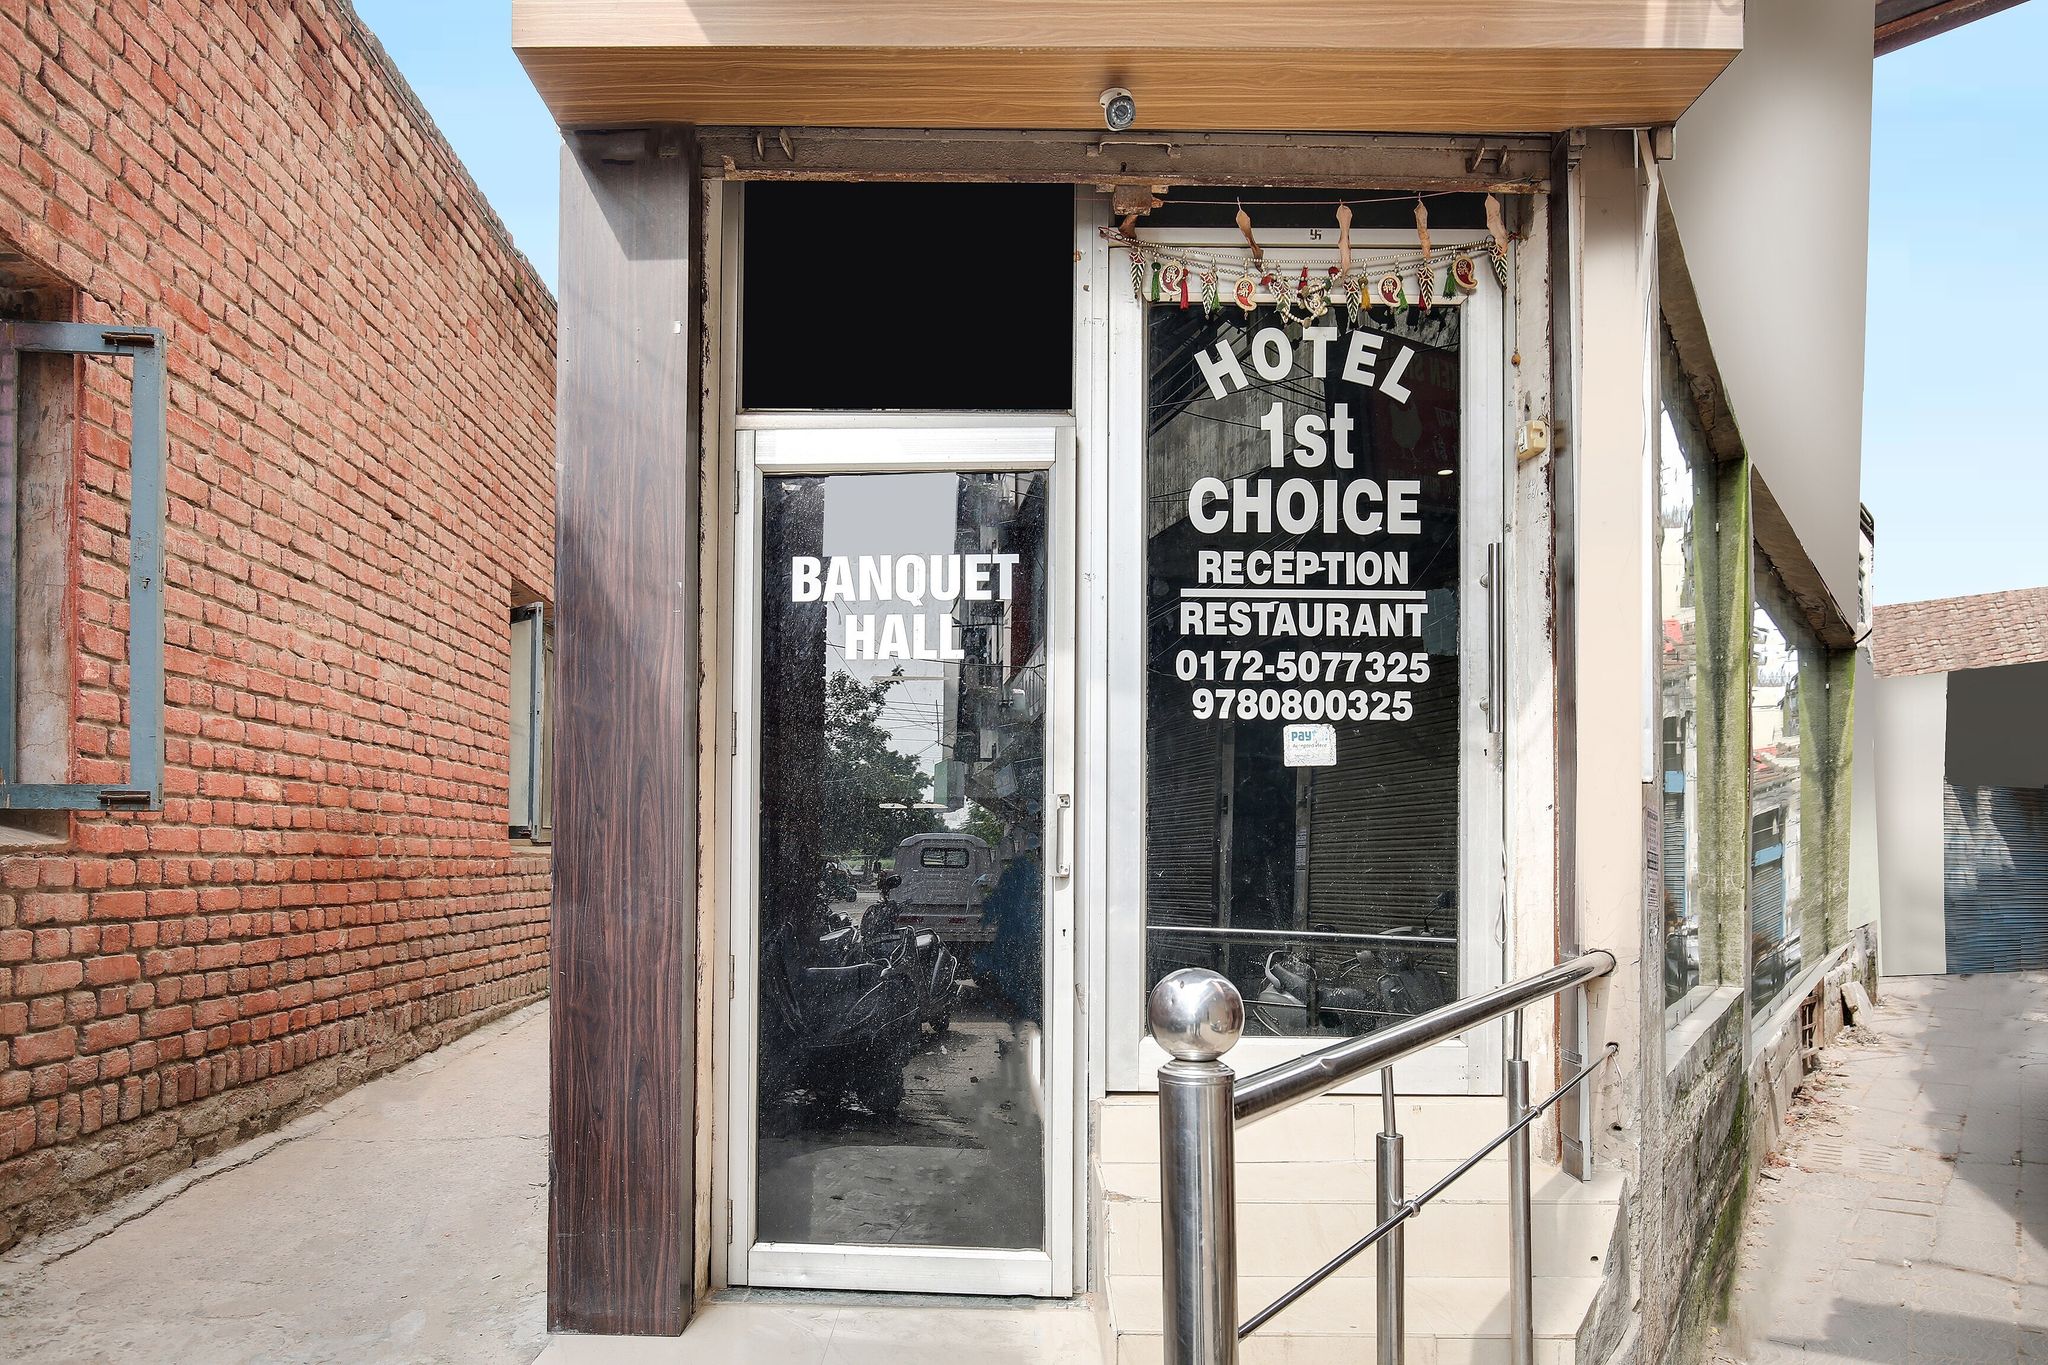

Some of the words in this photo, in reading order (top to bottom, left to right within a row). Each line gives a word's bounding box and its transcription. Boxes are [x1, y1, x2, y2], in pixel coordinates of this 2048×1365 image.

[1194, 326, 1416, 404] HOTEL
[1261, 402, 1354, 469] 1st
[1188, 477, 1422, 535] CHOICE
[791, 554, 1020, 607] BANQUET
[1198, 550, 1409, 586] RECEPTION
[845, 613, 965, 661] HALL
[1180, 601, 1428, 638] RESTAURANT
[1175, 650, 1431, 683] 0172-5077325
[1192, 688, 1413, 722] 9780800325
